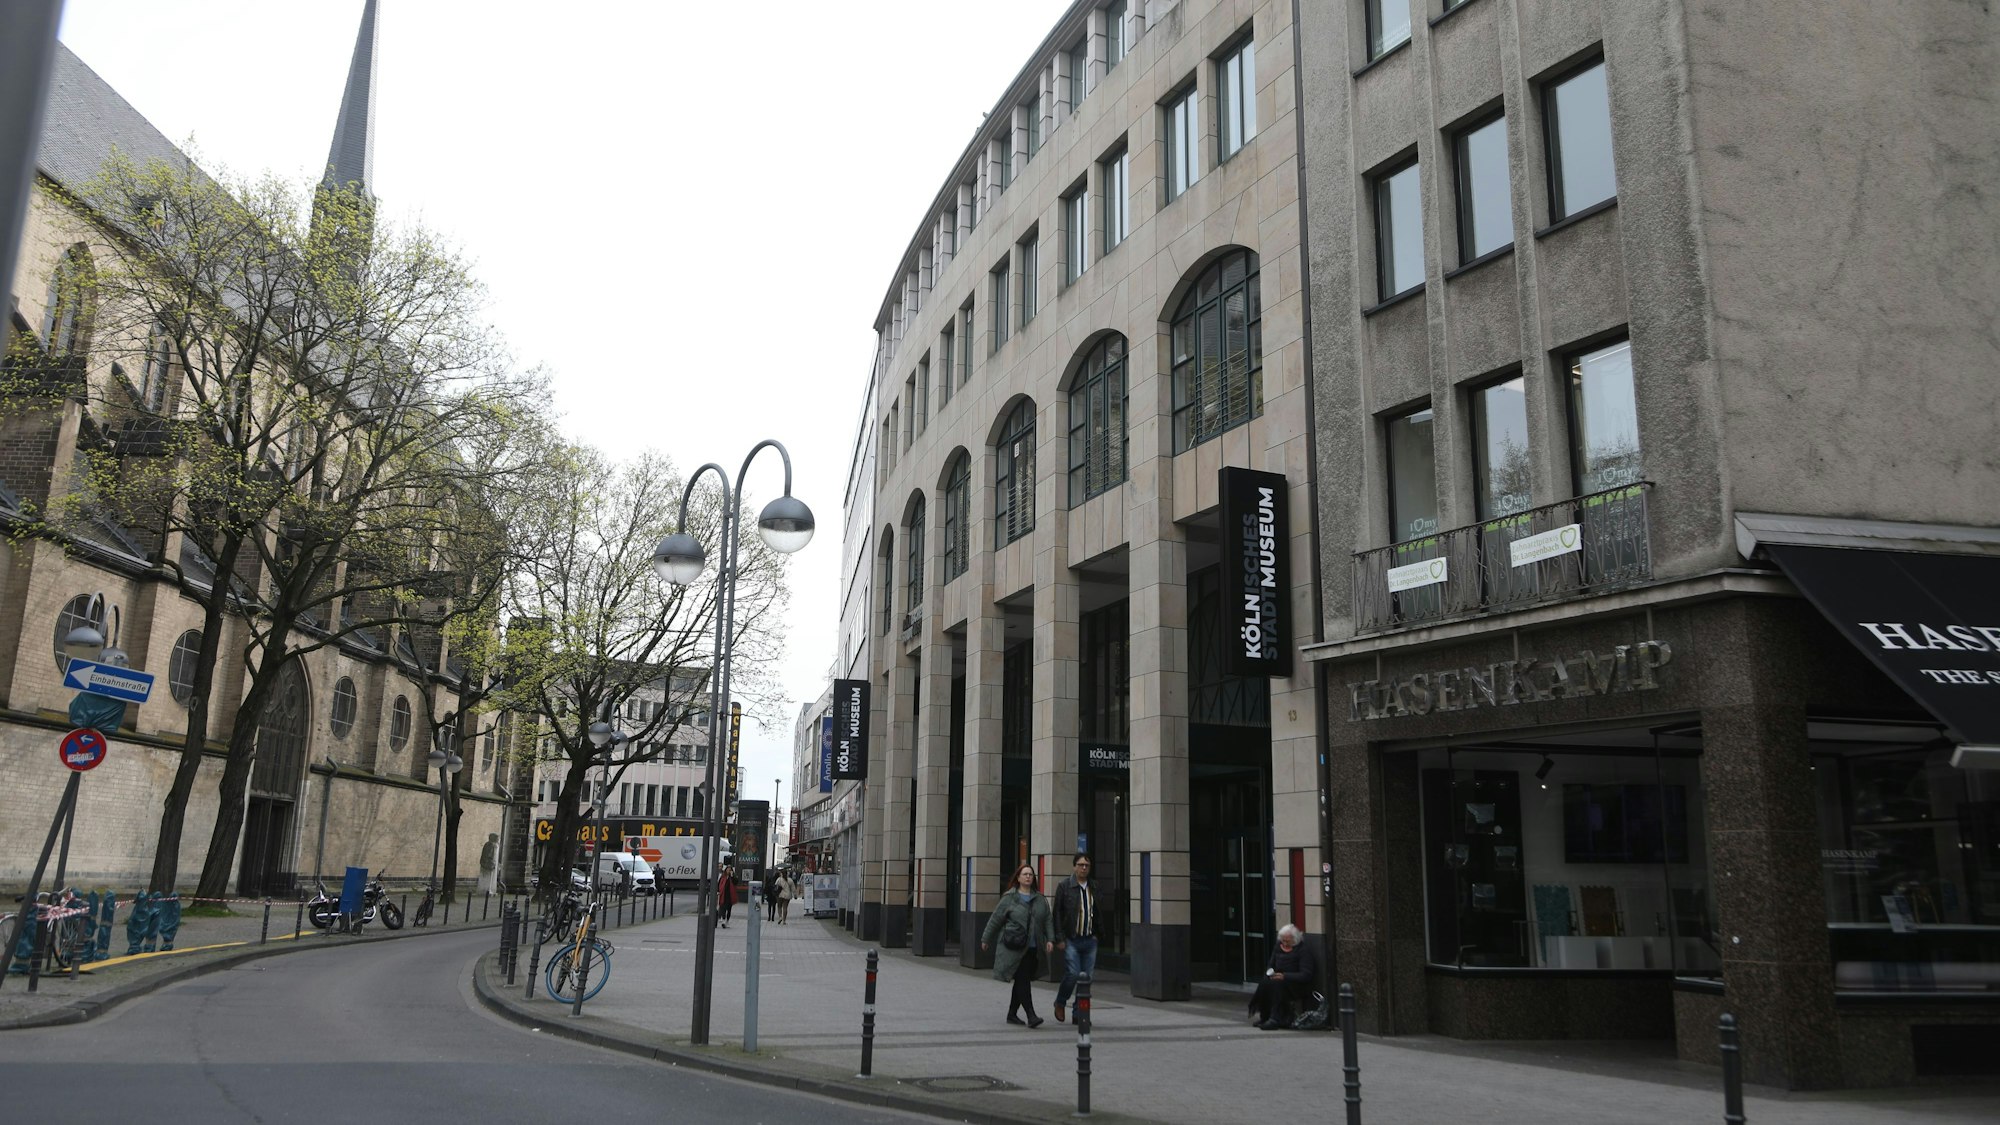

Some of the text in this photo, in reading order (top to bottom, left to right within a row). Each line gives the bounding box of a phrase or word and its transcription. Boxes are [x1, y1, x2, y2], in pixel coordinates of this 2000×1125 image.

[1424, 518, 1438, 529] my
[1259, 487, 1278, 660] STADTMUSEUM
[1241, 513, 1262, 658] KÖLNISCHES
[89, 673, 147, 692] Einbahnstraße
[1347, 640, 1672, 722] HASENKAMP
[1920, 669, 1990, 684] THE
[1287, 709, 1298, 722] 13
